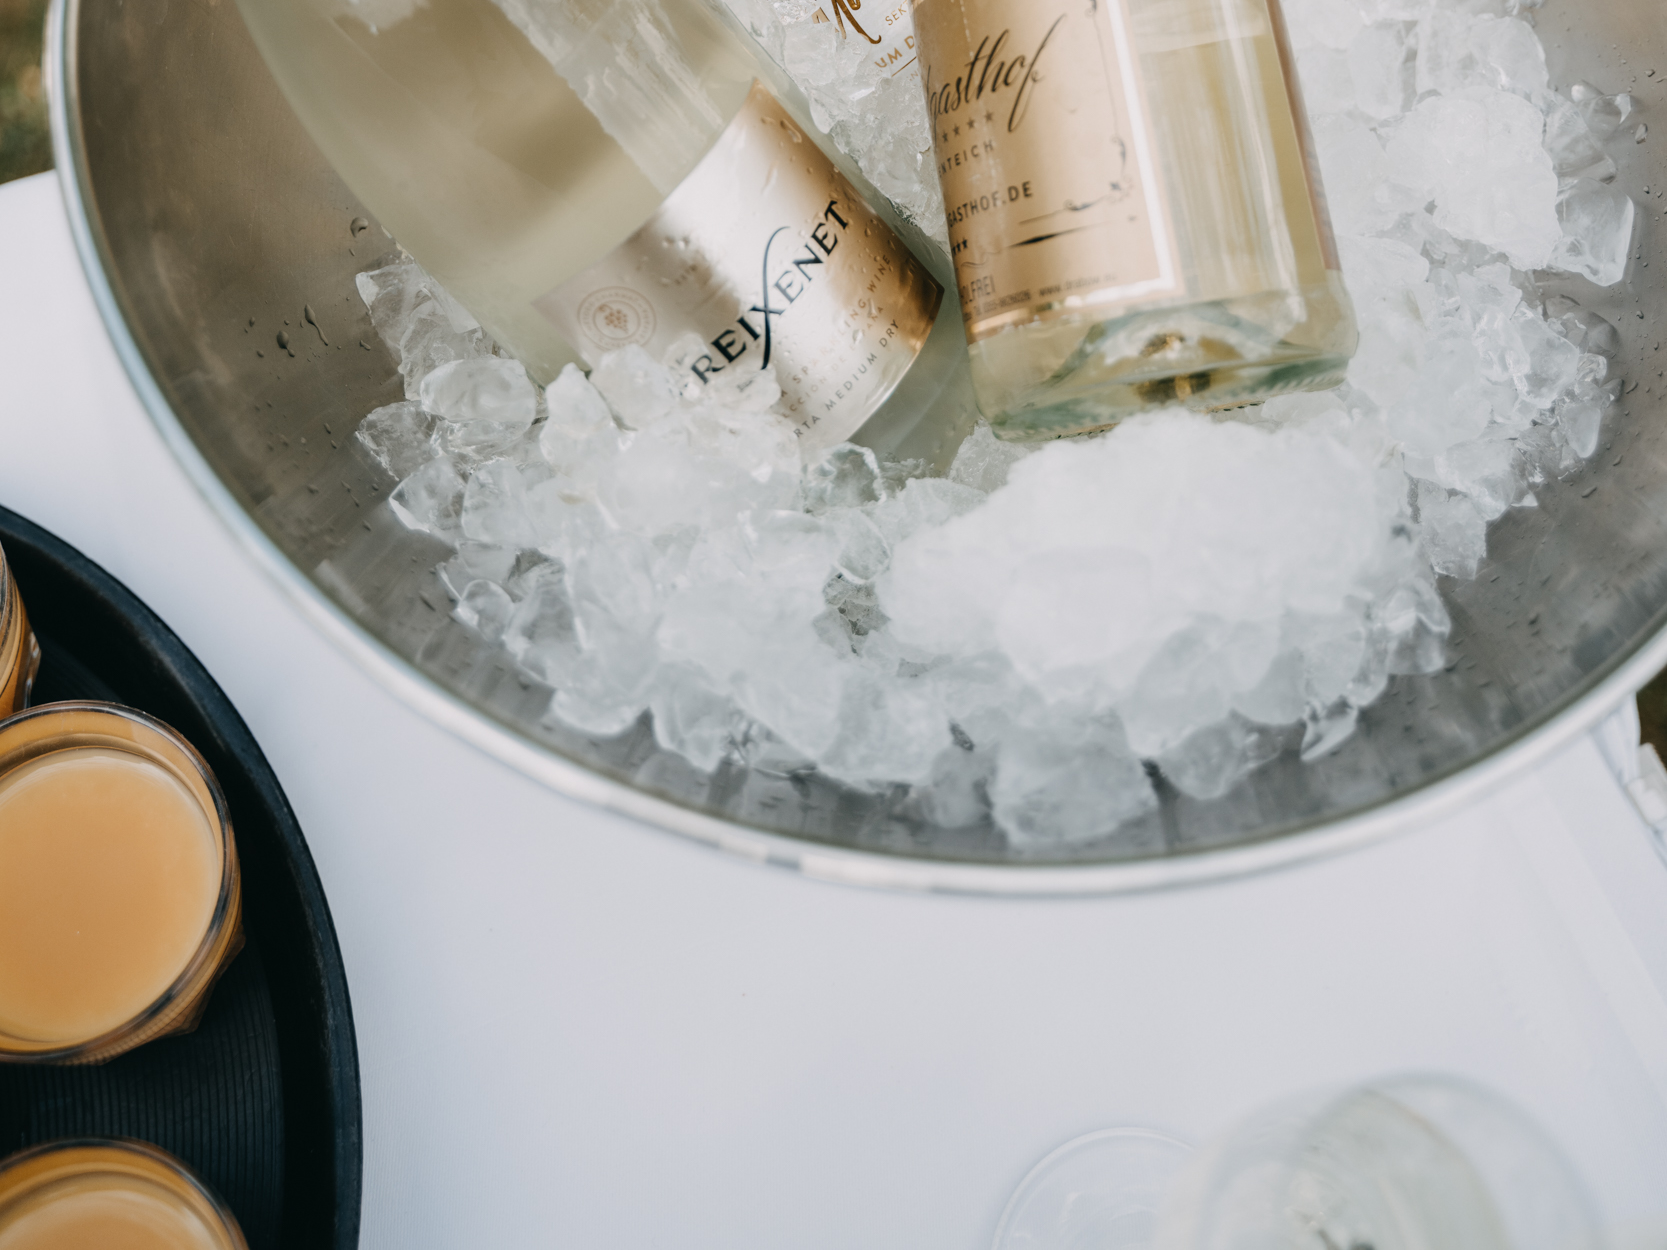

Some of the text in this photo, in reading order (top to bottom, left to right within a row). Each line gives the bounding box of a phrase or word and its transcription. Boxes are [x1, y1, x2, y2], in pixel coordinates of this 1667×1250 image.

[680, 199, 849, 394] REIXENET
[792, 254, 891, 384] SPARKLING WINE
[793, 319, 899, 438] RTA MEDIUM DRY
